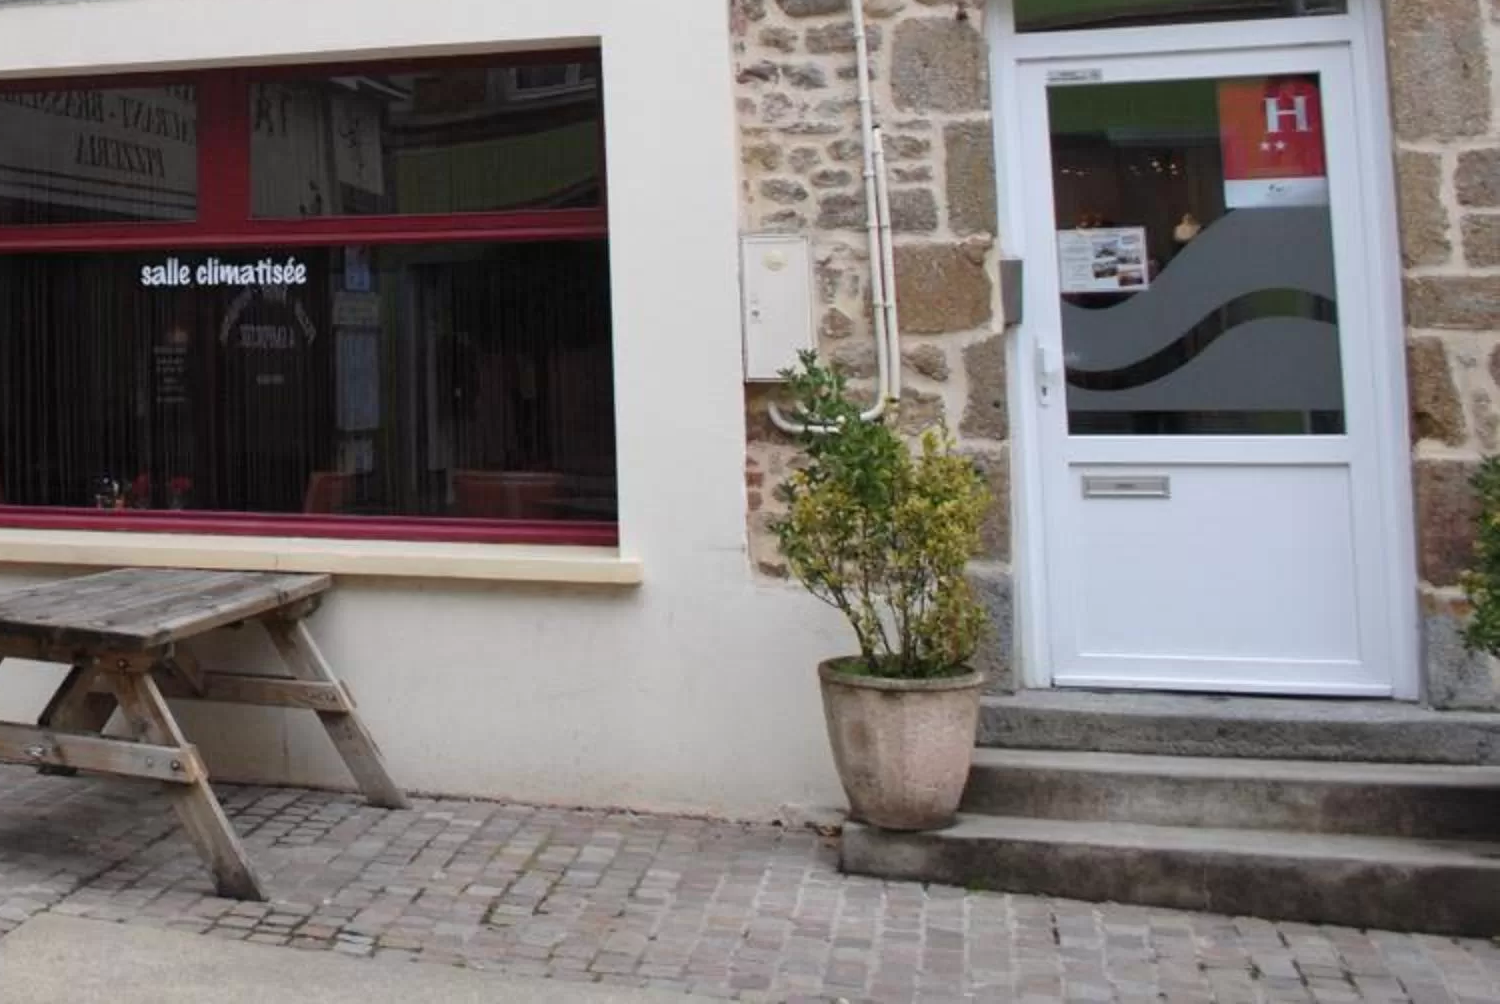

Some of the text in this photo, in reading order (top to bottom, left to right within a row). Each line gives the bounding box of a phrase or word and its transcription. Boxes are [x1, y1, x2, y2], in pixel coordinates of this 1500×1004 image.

[1264, 95, 1312, 133] H
[141, 256, 307, 287] salle climatisée
